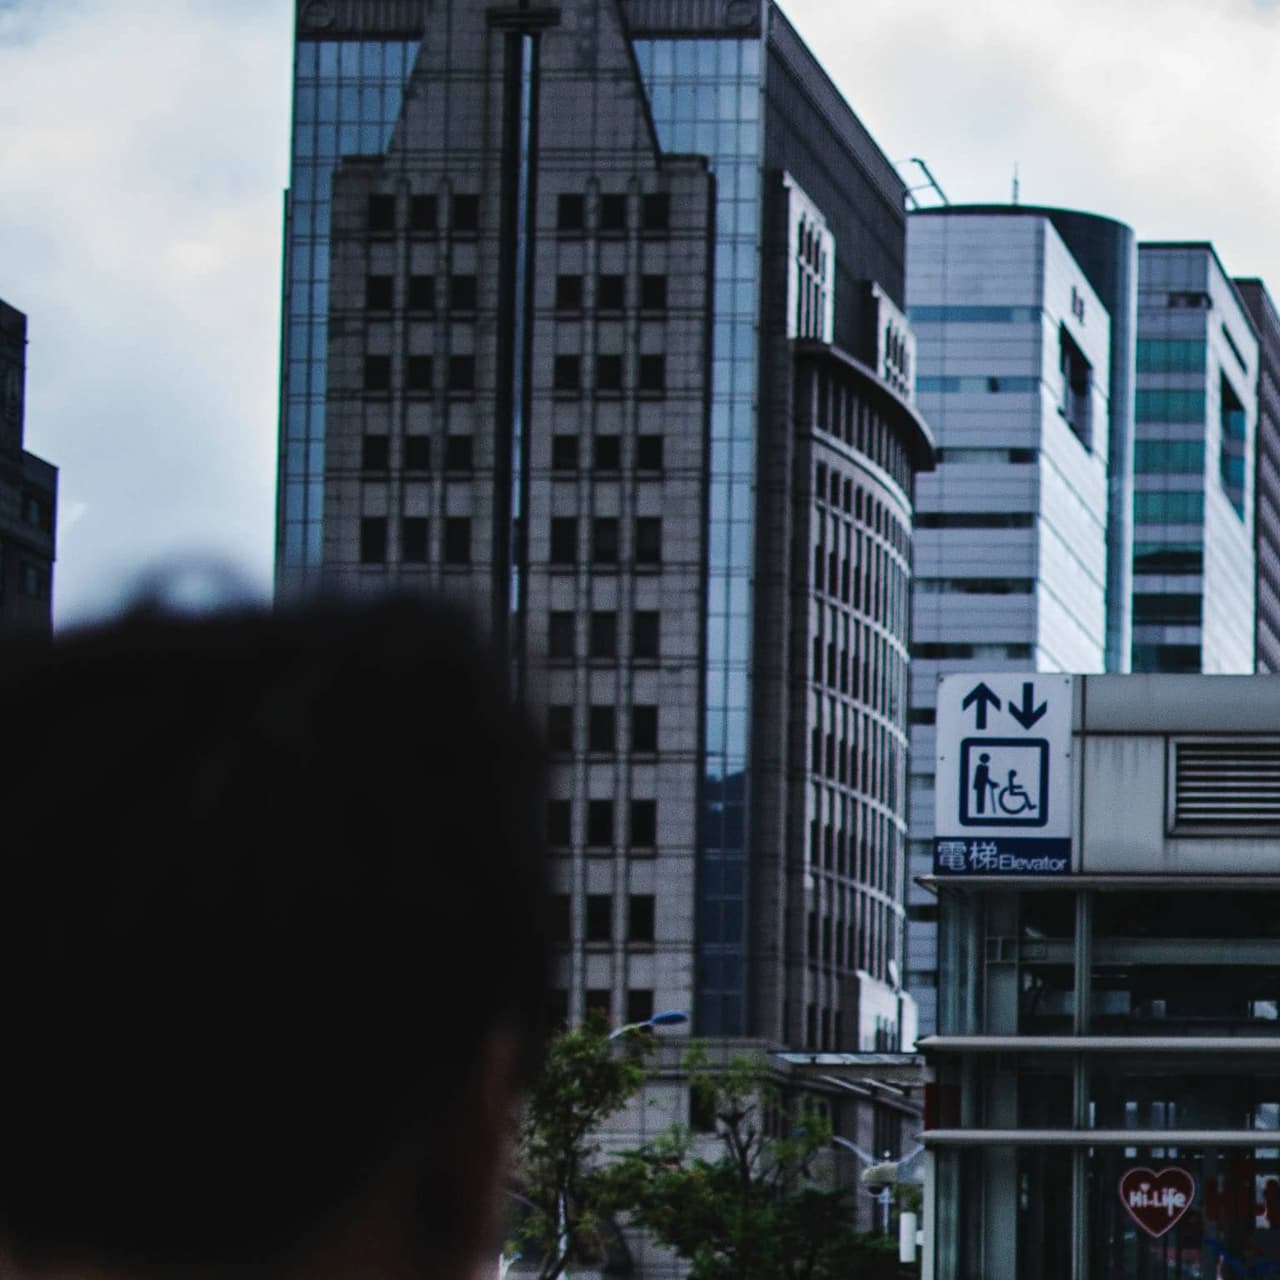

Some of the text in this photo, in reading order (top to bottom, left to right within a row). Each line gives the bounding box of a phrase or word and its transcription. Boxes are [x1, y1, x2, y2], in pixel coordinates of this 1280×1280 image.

[938, 841, 997, 870] 電梯
[1000, 854, 1066, 870] Elevator
[1129, 1183, 1186, 1216] Hi-Life
